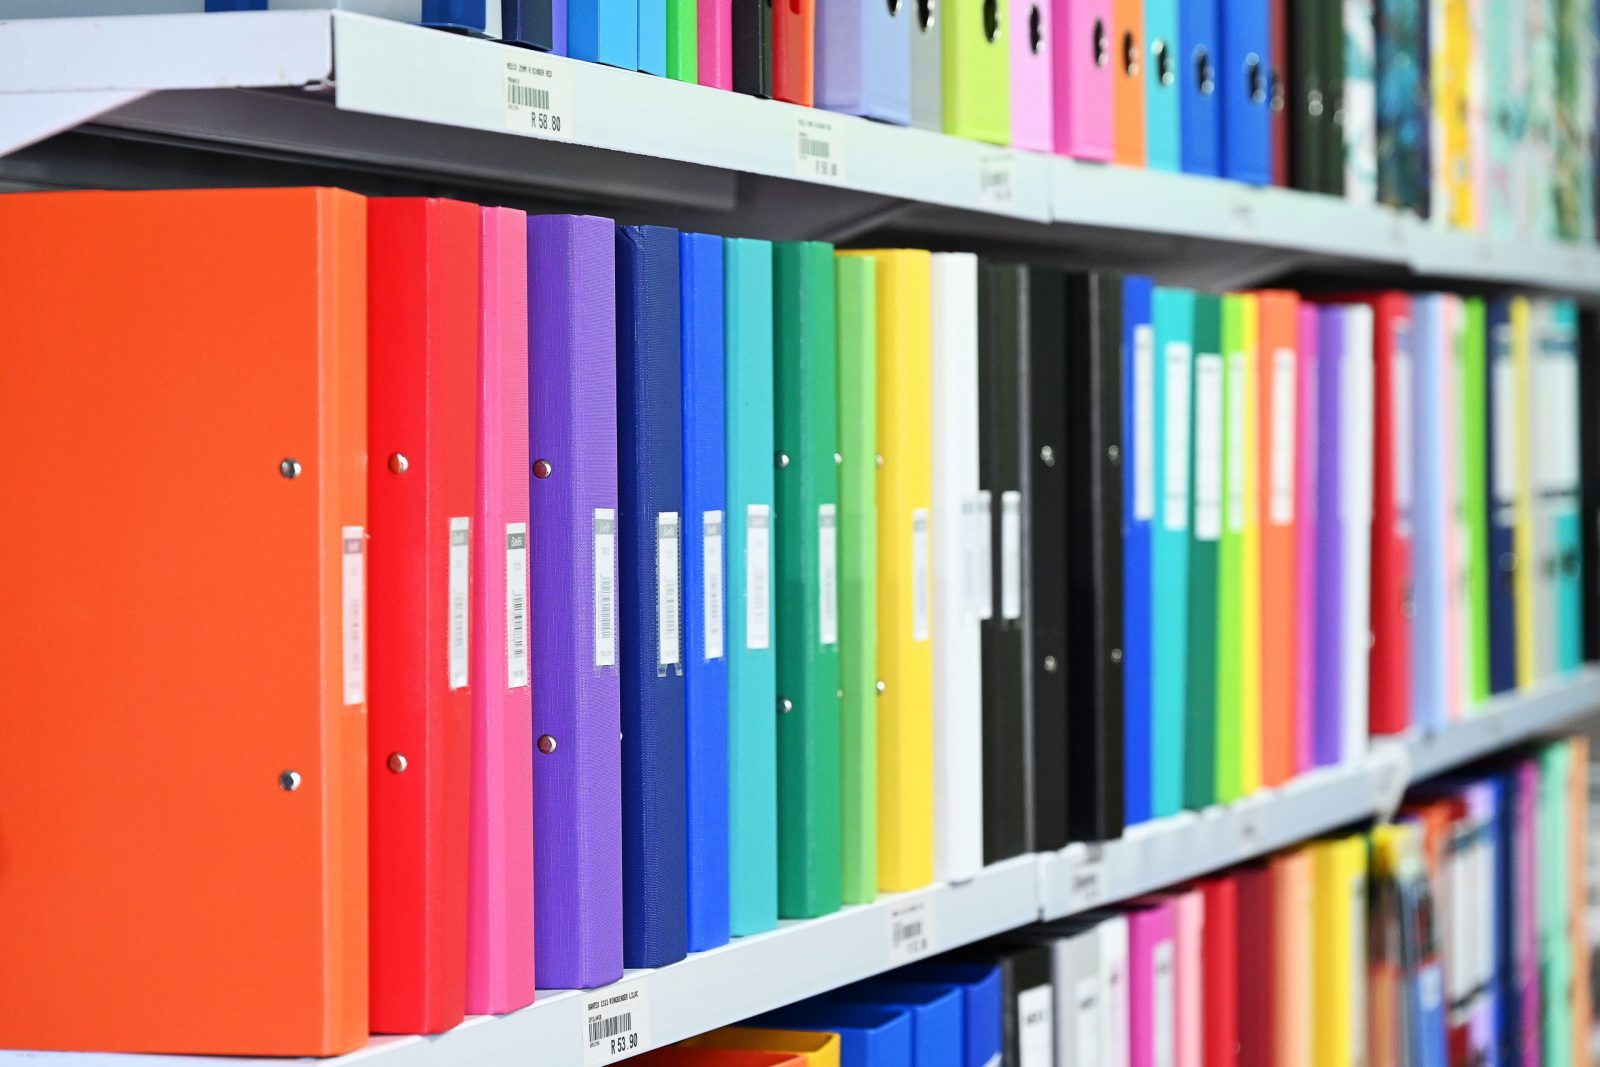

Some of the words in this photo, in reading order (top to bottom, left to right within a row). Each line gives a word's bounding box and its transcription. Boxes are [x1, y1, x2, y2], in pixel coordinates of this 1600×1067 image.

[531, 112, 536, 128] R
[538, 113, 561, 132] 58.80
[611, 1039, 616, 1055] R
[617, 1032, 638, 1053] 53.90
